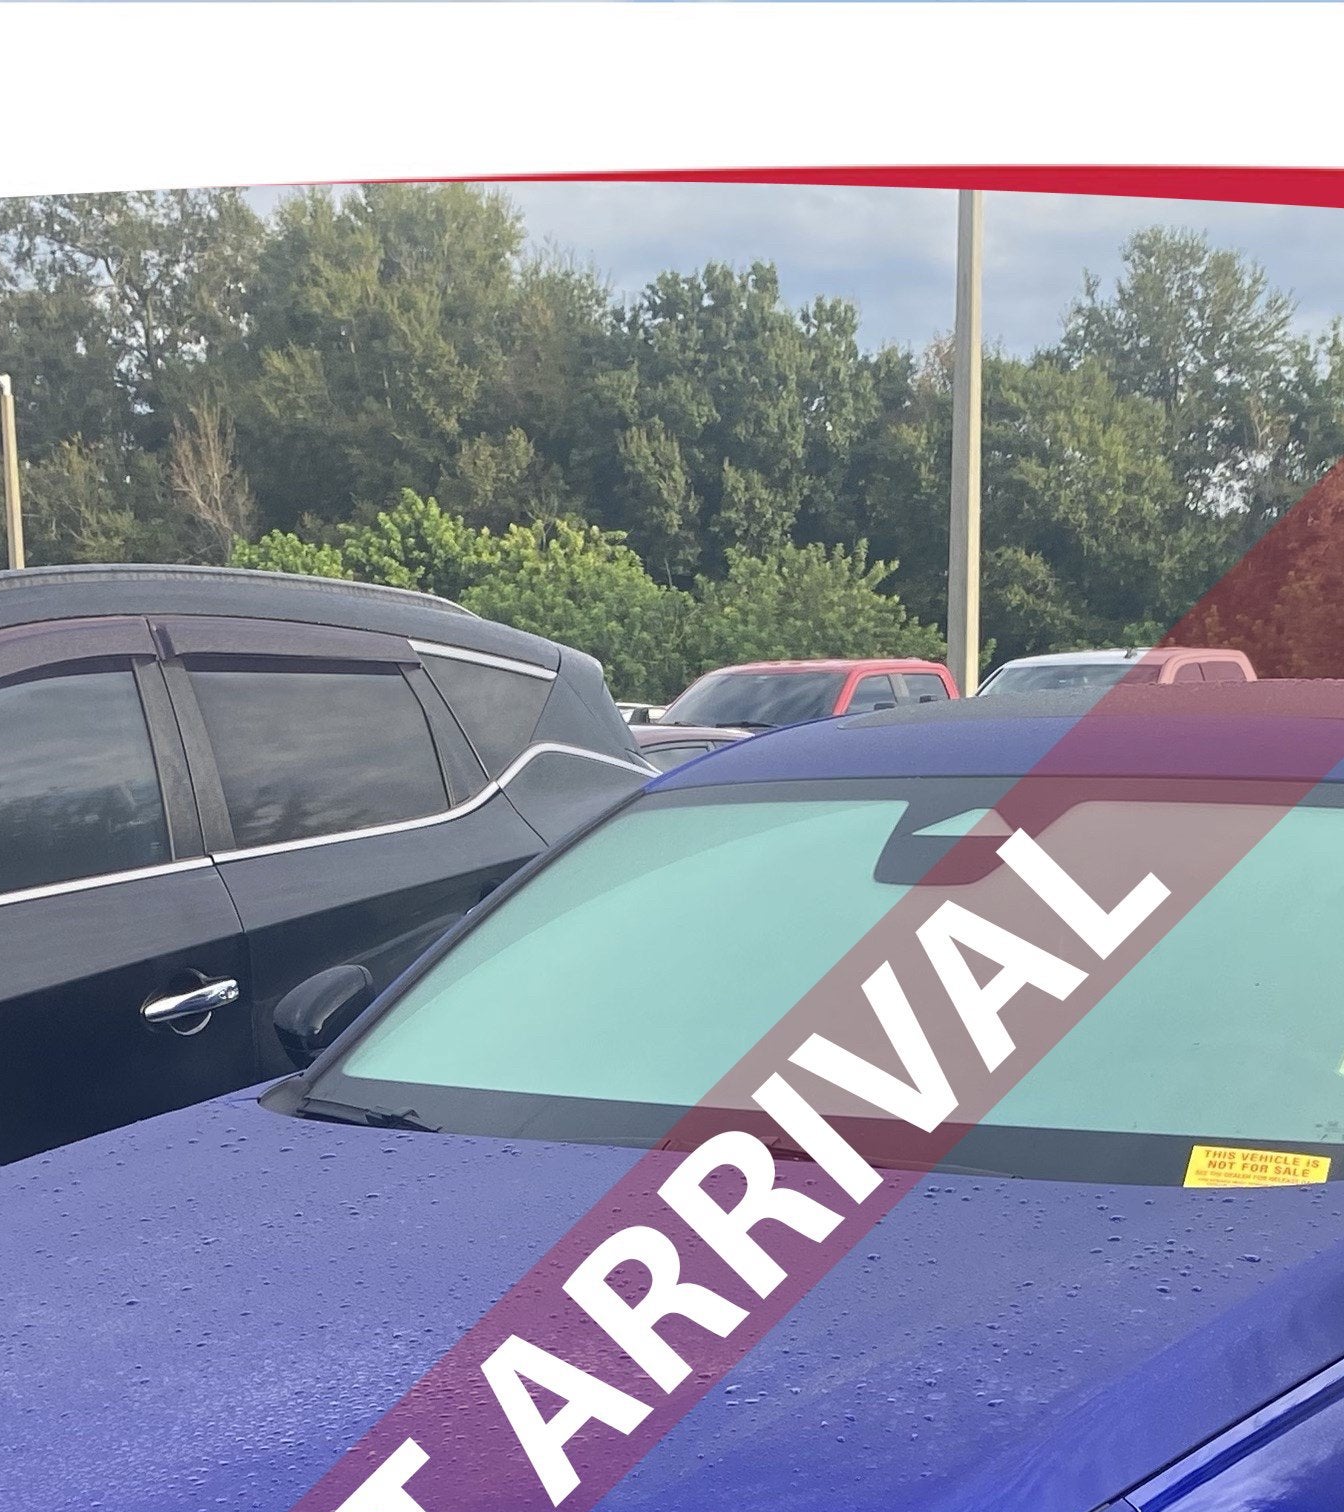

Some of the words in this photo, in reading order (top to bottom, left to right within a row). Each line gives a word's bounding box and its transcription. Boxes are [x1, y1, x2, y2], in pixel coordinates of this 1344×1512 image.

[1204, 1150, 1236, 1160] THIS
[1241, 1153, 1301, 1167] VEHICLE
[1306, 1158, 1320, 1169] IS
[1207, 1160, 1236, 1170] NOT
[1241, 1162, 1269, 1174] FOR
[1274, 1165, 1310, 1178] SALE
